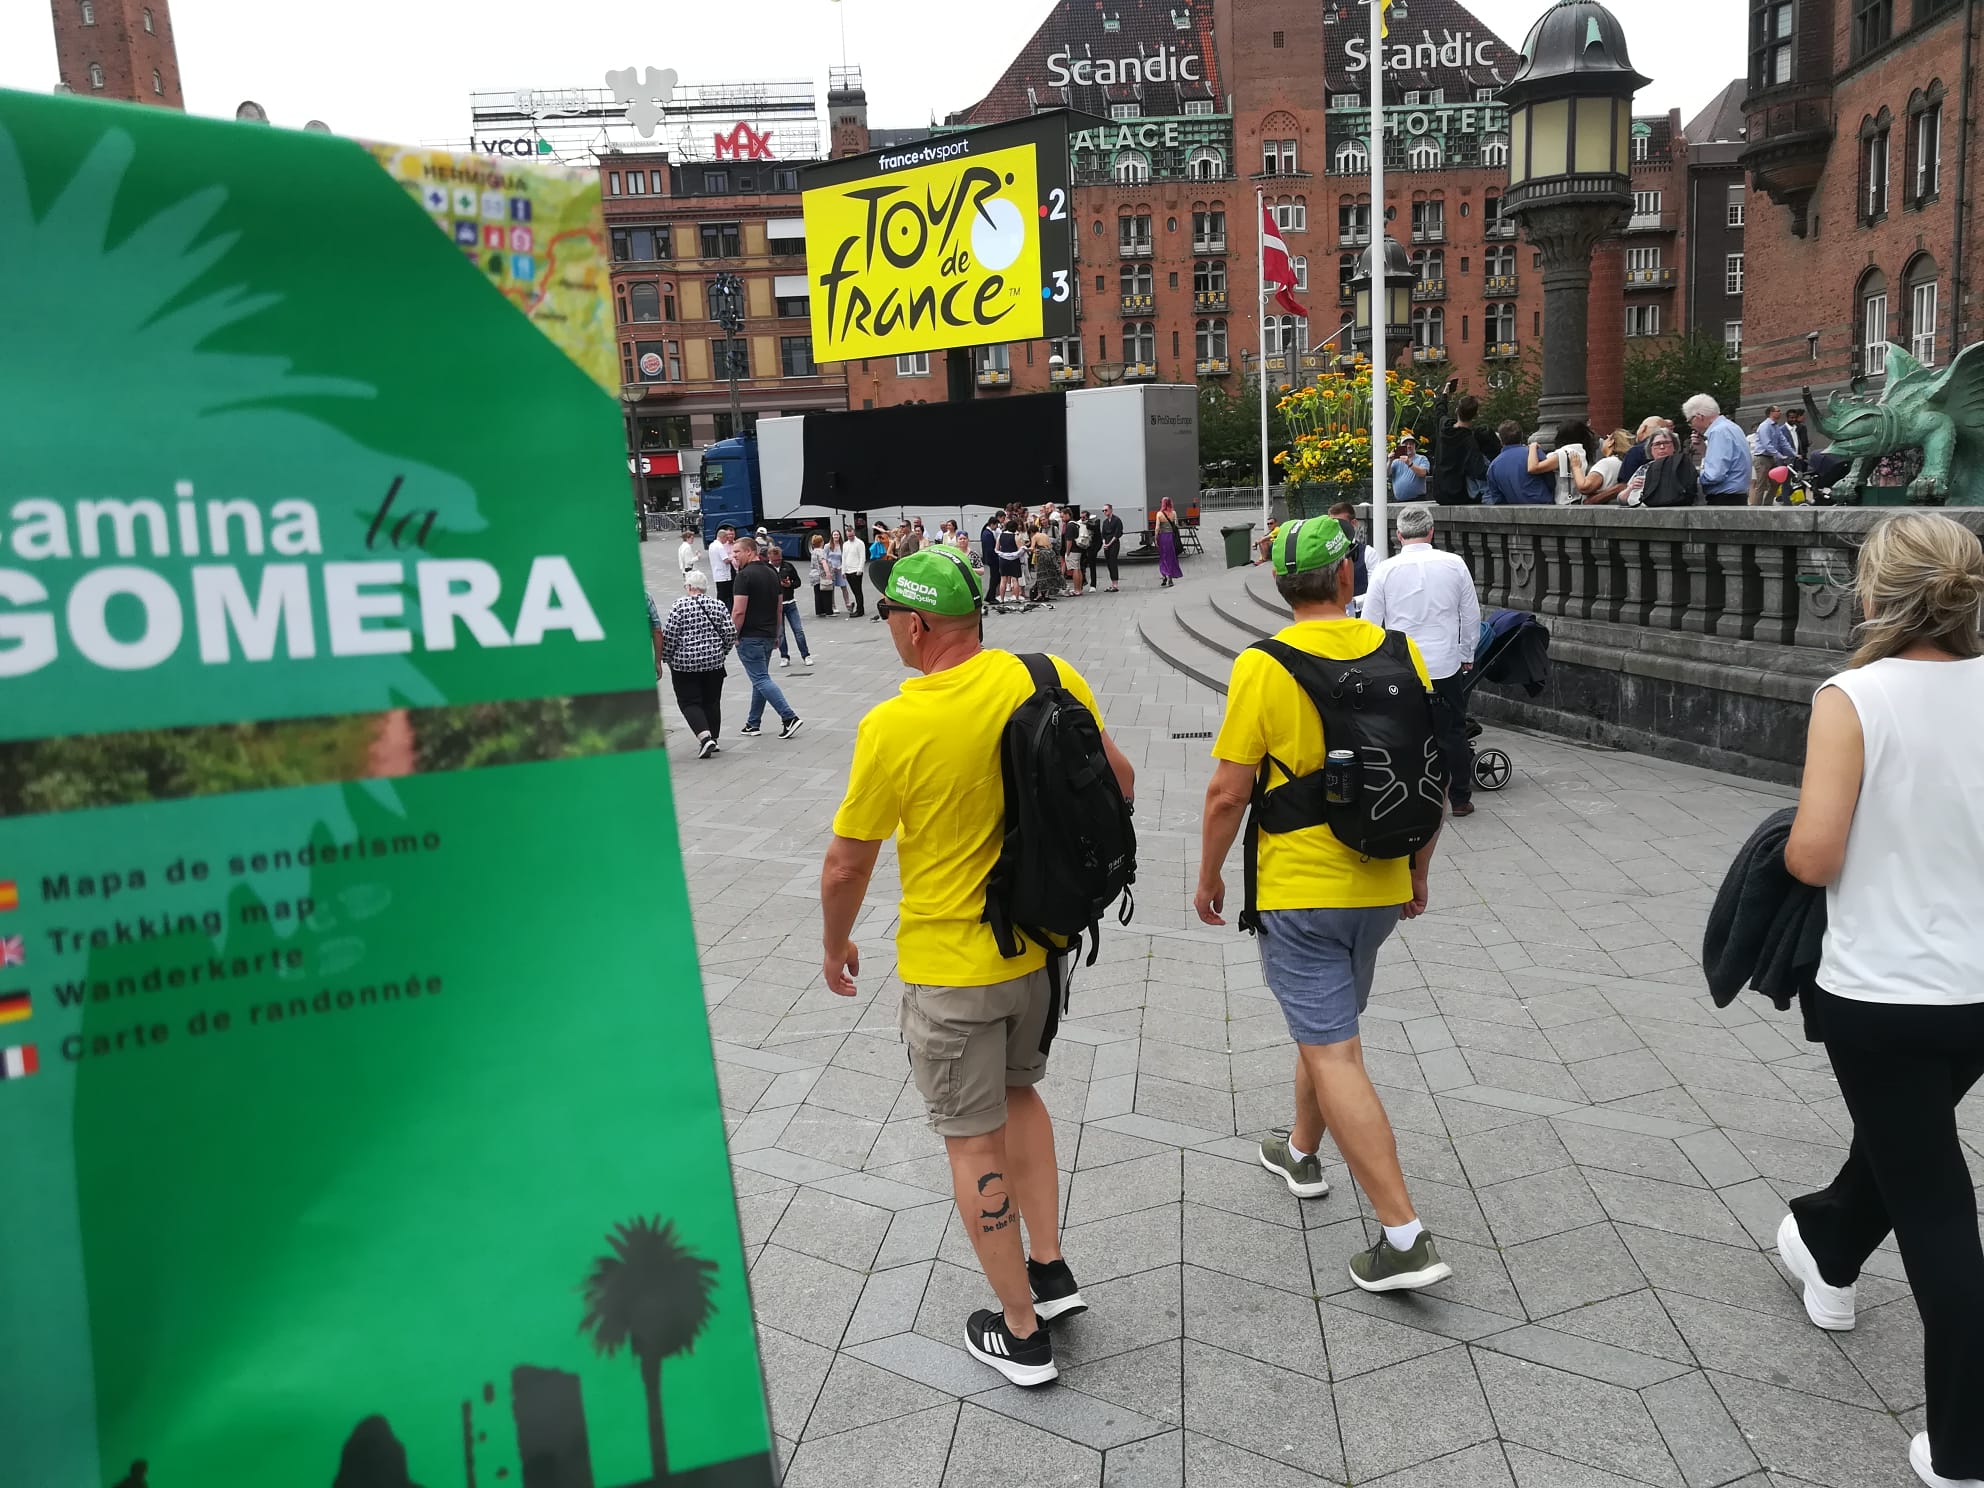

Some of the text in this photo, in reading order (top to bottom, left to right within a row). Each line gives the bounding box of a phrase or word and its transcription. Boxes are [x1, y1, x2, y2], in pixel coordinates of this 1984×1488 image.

[1047, 46, 1200, 87] Scandic
[713, 120, 776, 160] MAX
[1069, 122, 1179, 151] ALACE
[1381, 108, 1499, 136] HOTEL
[422, 163, 528, 192] HERMIGUA
[842, 166, 1003, 277] TOUR
[940, 239, 971, 276] de
[0, 474, 447, 560] amina la
[896, 576, 938, 597] ŠKODA
[41, 830, 442, 902] Mapa de senderismo
[47, 896, 316, 956] Trekking map
[54, 946, 305, 1008] Wanderkarte
[61, 973, 444, 1062] Carte de randonnée
